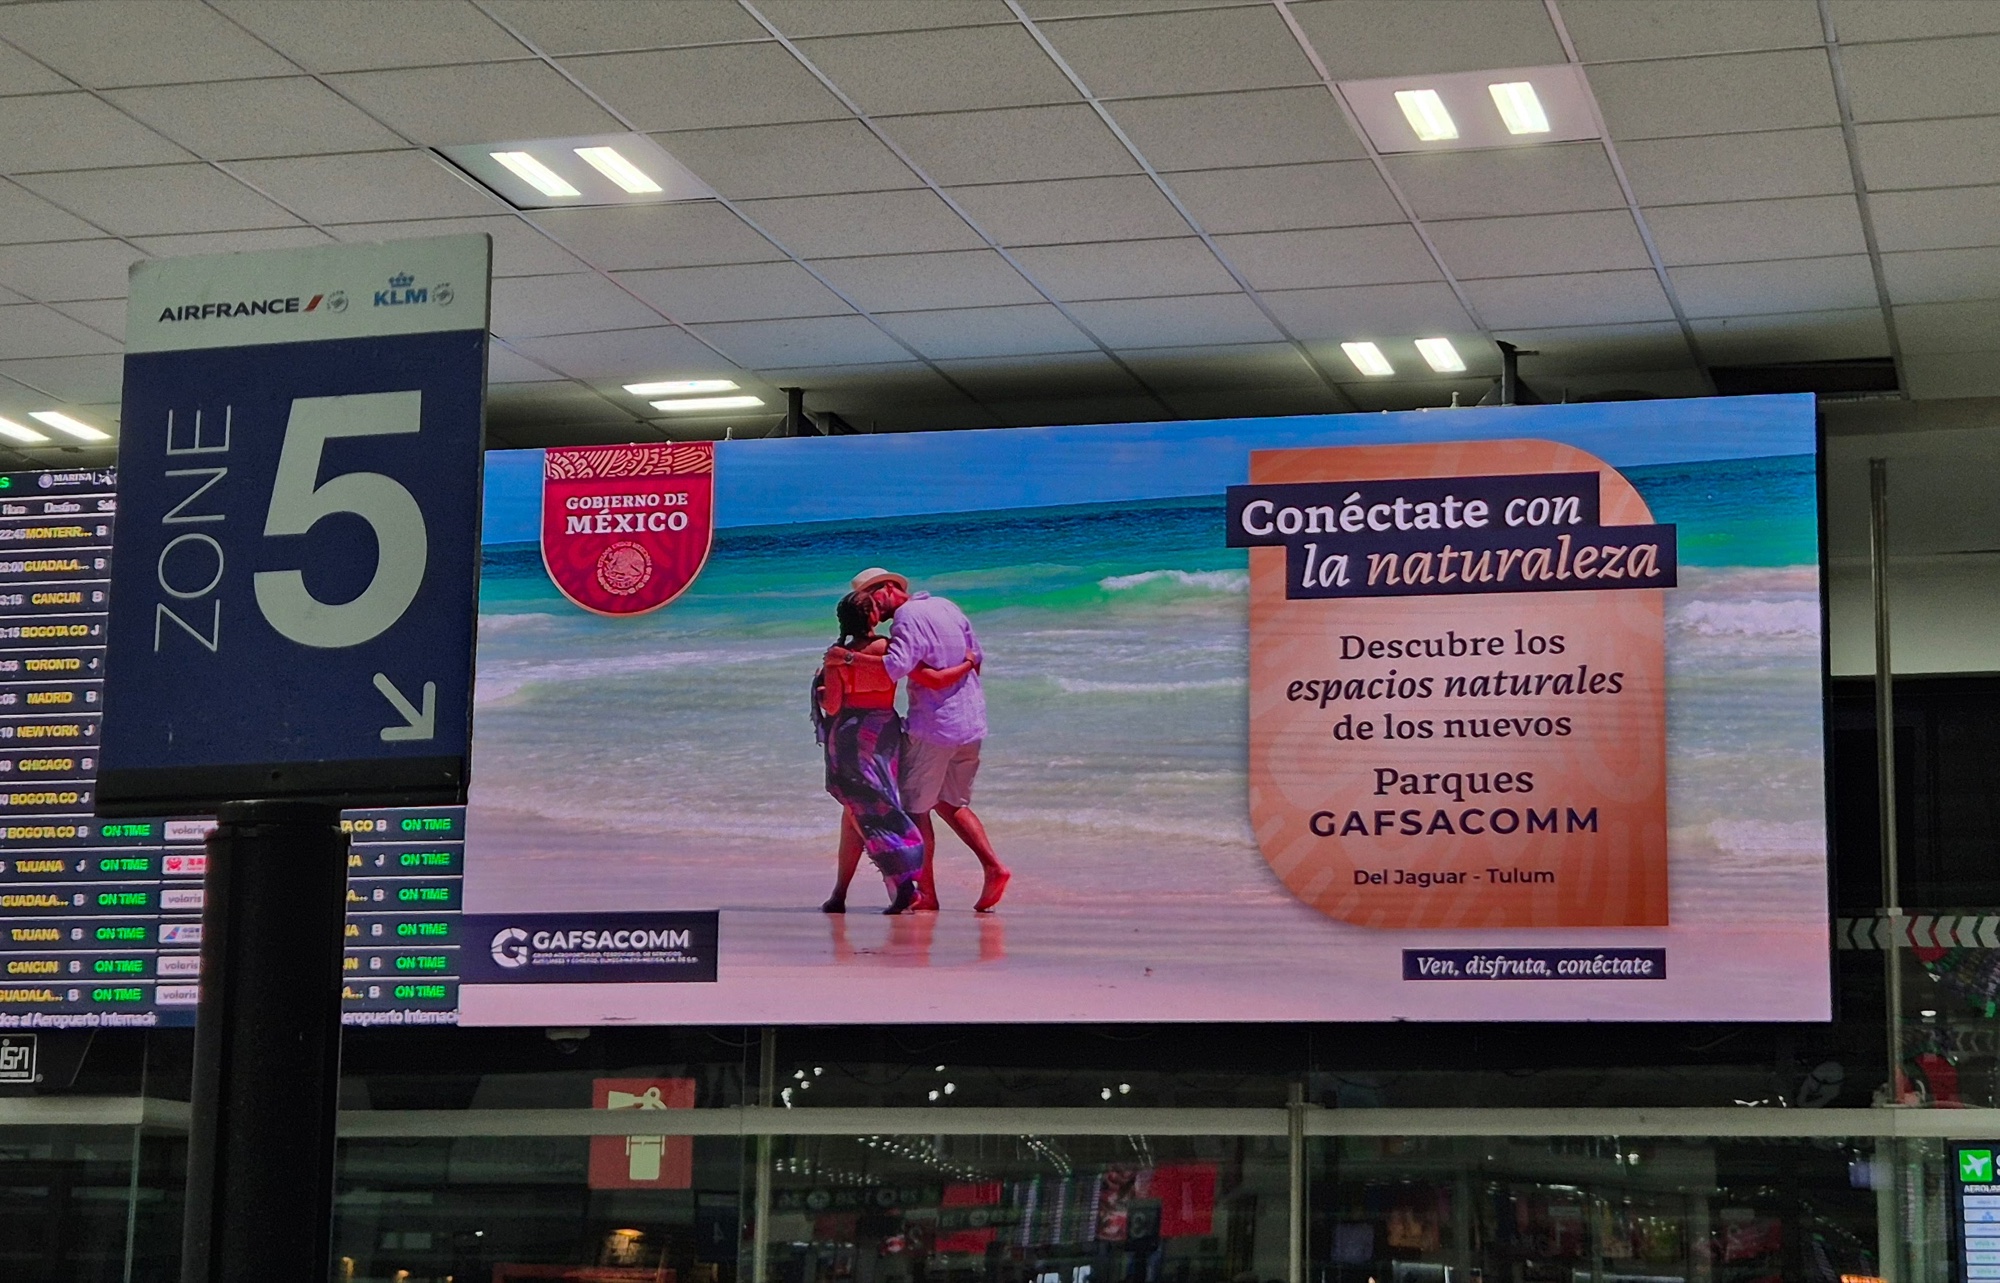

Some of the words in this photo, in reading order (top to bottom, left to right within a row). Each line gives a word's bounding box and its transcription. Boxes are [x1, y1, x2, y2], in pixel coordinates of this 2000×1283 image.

[158, 297, 300, 323] AIRFRANCE
[373, 288, 428, 307] KLM
[565, 494, 661, 510] GOBIERNO
[663, 492, 689, 506] DE
[154, 404, 232, 652] ZONE
[253, 389, 428, 648] 5
[1241, 492, 1489, 536] Conéctate
[1503, 493, 1582, 527] con
[564, 508, 689, 535] MÉXICO
[96, 525, 107, 537] B
[94, 558, 105, 570] B
[1301, 543, 1351, 588] la
[1366, 534, 1661, 587] naturaleza
[32, 592, 81, 604] CANCUN
[92, 590, 103, 602] B
[90, 624, 100, 635] J
[1339, 631, 1505, 660] Descubre
[1515, 629, 1566, 656] los
[25, 658, 80, 671] TORONTO
[88, 657, 98, 669] J
[1286, 669, 1434, 709] espacios
[1443, 664, 1625, 699] naturales
[27, 691, 73, 705] MADRID
[85, 690, 97, 703] B
[84, 724, 95, 736] J
[1333, 714, 1374, 740] de
[1383, 713, 1434, 740] los
[1443, 715, 1572, 738] nuevos
[19, 758, 73, 772] CHICAGO
[81, 758, 93, 770] B
[1373, 767, 1535, 802] Parques
[80, 792, 90, 804] J
[376, 819, 387, 831] B
[401, 819, 421, 830] ON
[422, 818, 451, 830] TIME
[1308, 806, 1599, 837] GAFSACOMM
[77, 825, 88, 837] B
[102, 825, 121, 837] ON
[122, 824, 150, 836] TIME
[76, 859, 86, 872] J
[100, 859, 119, 871] ON
[120, 858, 148, 870] TIME
[374, 854, 385, 867] J
[400, 854, 420, 866] ON
[421, 853, 450, 865] TIME
[1353, 869, 1390, 885] Del
[1394, 869, 1467, 888] Jaguar
[1486, 868, 1555, 884] Tulum
[73, 893, 85, 906] B
[98, 893, 117, 906] ON
[118, 893, 146, 905] TIME
[373, 888, 385, 901] B
[399, 888, 418, 900] ON
[420, 888, 449, 900] TIME
[71, 928, 83, 940] B
[97, 928, 116, 940] ON
[117, 927, 145, 939] TIME
[371, 923, 382, 936] B
[397, 924, 417, 936] ON
[419, 923, 448, 935] TIME
[532, 929, 691, 949] GAFSACOMM
[7, 960, 59, 973] CANCUN
[69, 960, 81, 973] B
[94, 960, 113, 972] ON
[114, 960, 142, 971] TIME
[370, 956, 381, 969] B
[396, 957, 416, 968] ON
[417, 956, 446, 968] TIME
[1416, 956, 1460, 976] Ven,
[1465, 954, 1552, 978] disfruta,
[1556, 954, 1654, 975] conéctate
[67, 989, 79, 1001] B
[92, 989, 111, 1001] ON
[113, 989, 141, 1000] TIME
[368, 986, 380, 998] B
[394, 986, 414, 998] ON
[416, 985, 446, 997] TIME
